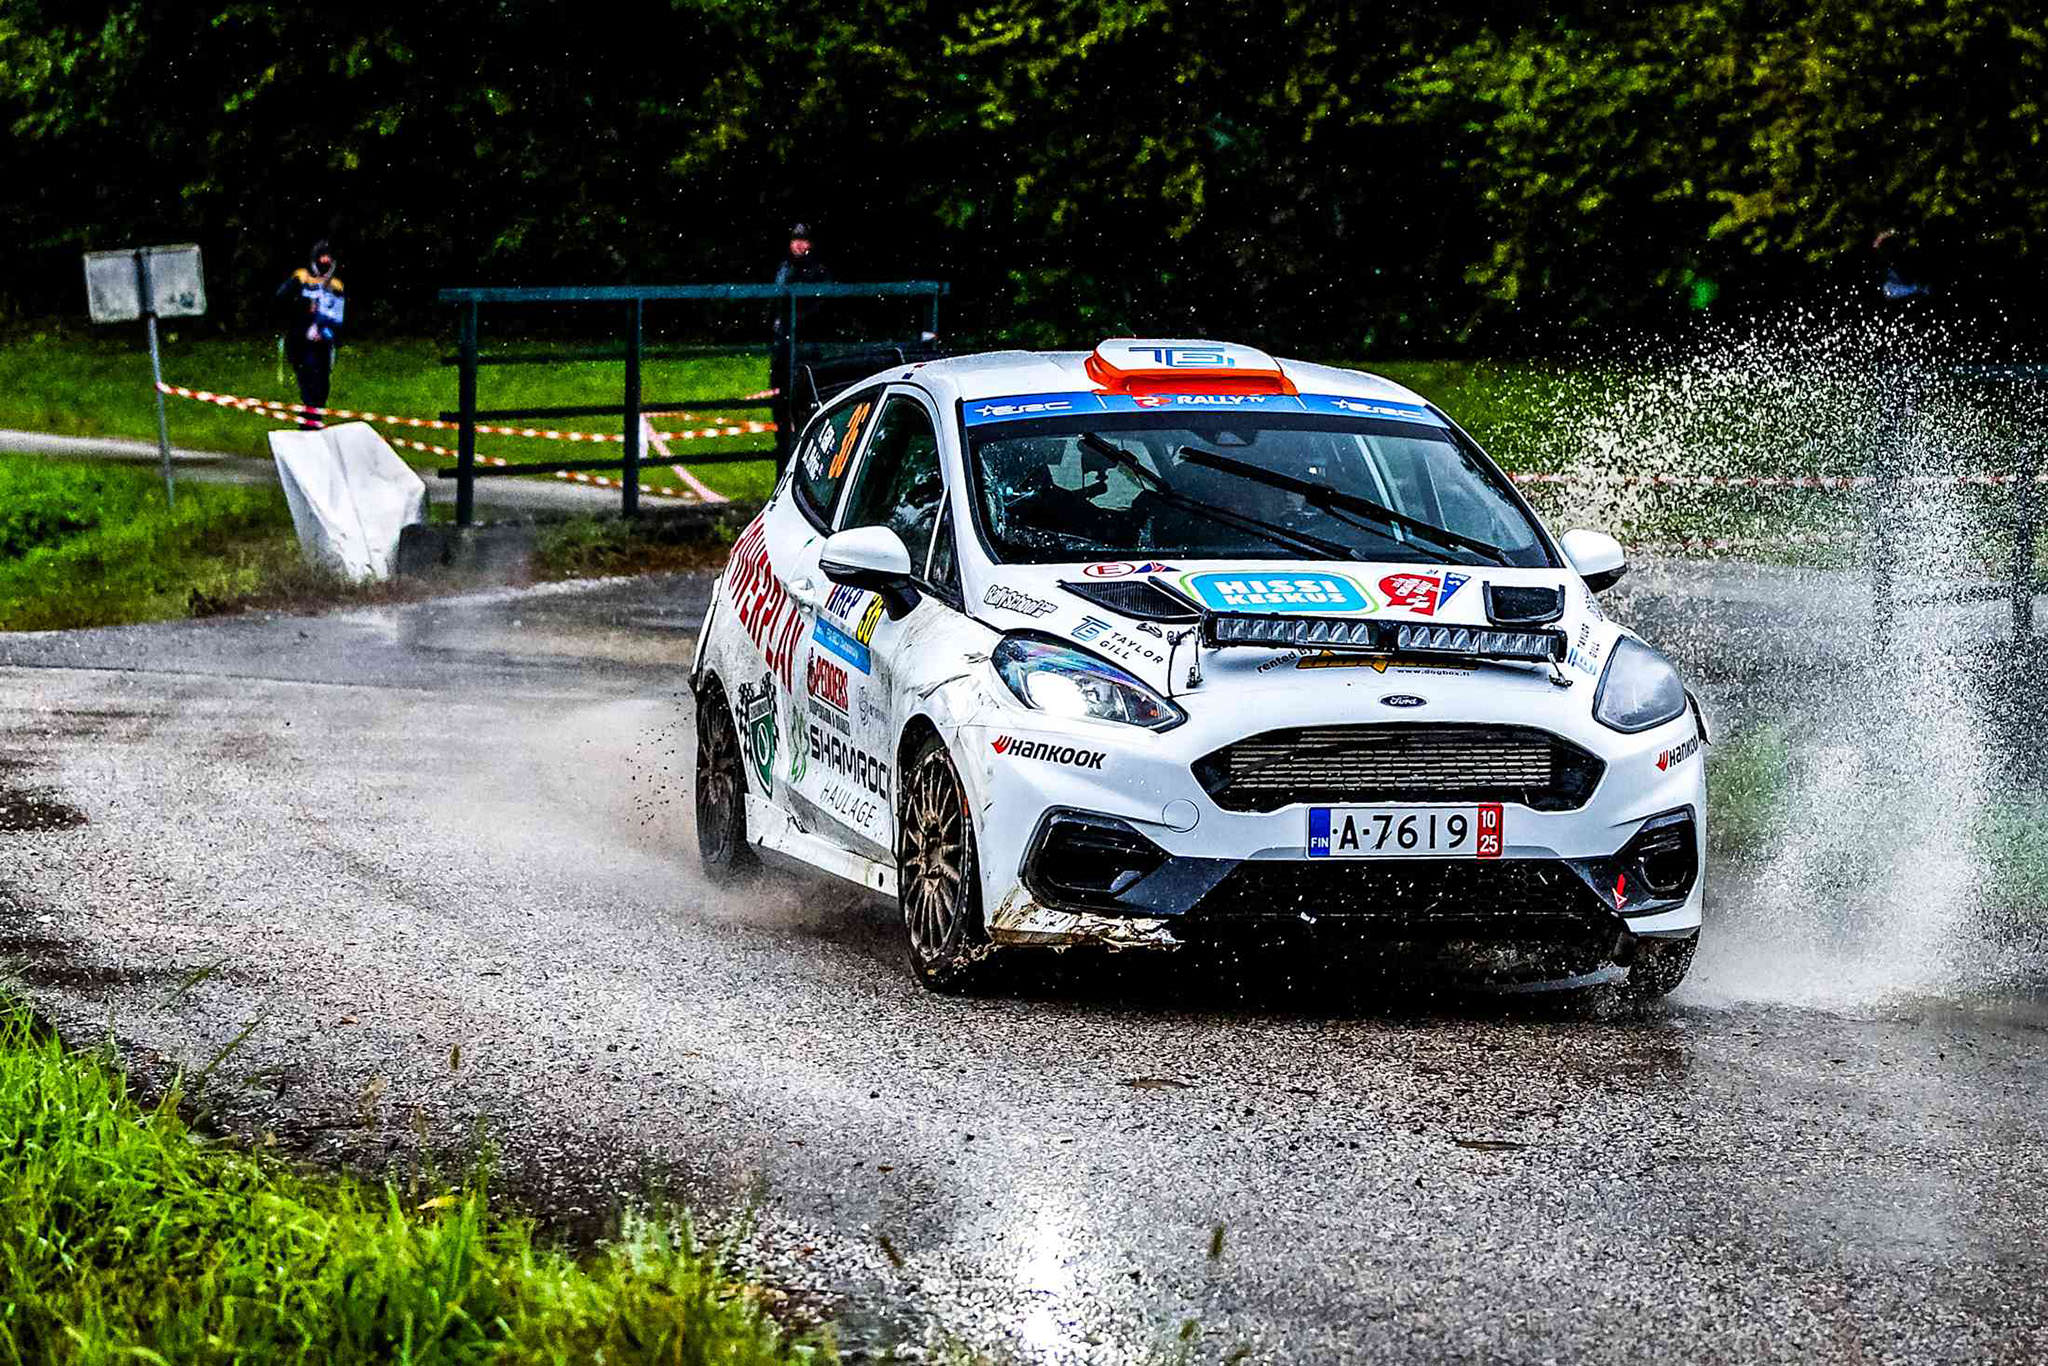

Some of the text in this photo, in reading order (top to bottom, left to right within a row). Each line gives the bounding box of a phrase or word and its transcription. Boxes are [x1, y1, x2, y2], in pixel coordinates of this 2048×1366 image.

[1176, 395, 1244, 405] RALLY
[1213, 580, 1340, 595] HISSI
[1222, 593, 1347, 605] KESKUS
[1099, 639, 1129, 660] GILL
[1111, 632, 1164, 664] TAYLOR
[1256, 651, 1297, 673] rented
[816, 656, 849, 711] PEDDERS
[1388, 695, 1418, 706] Ford
[820, 781, 877, 828] HAULAGE
[1481, 811, 1496, 828] 10
[1311, 837, 1329, 848] FIN
[1480, 835, 1498, 852] 25
